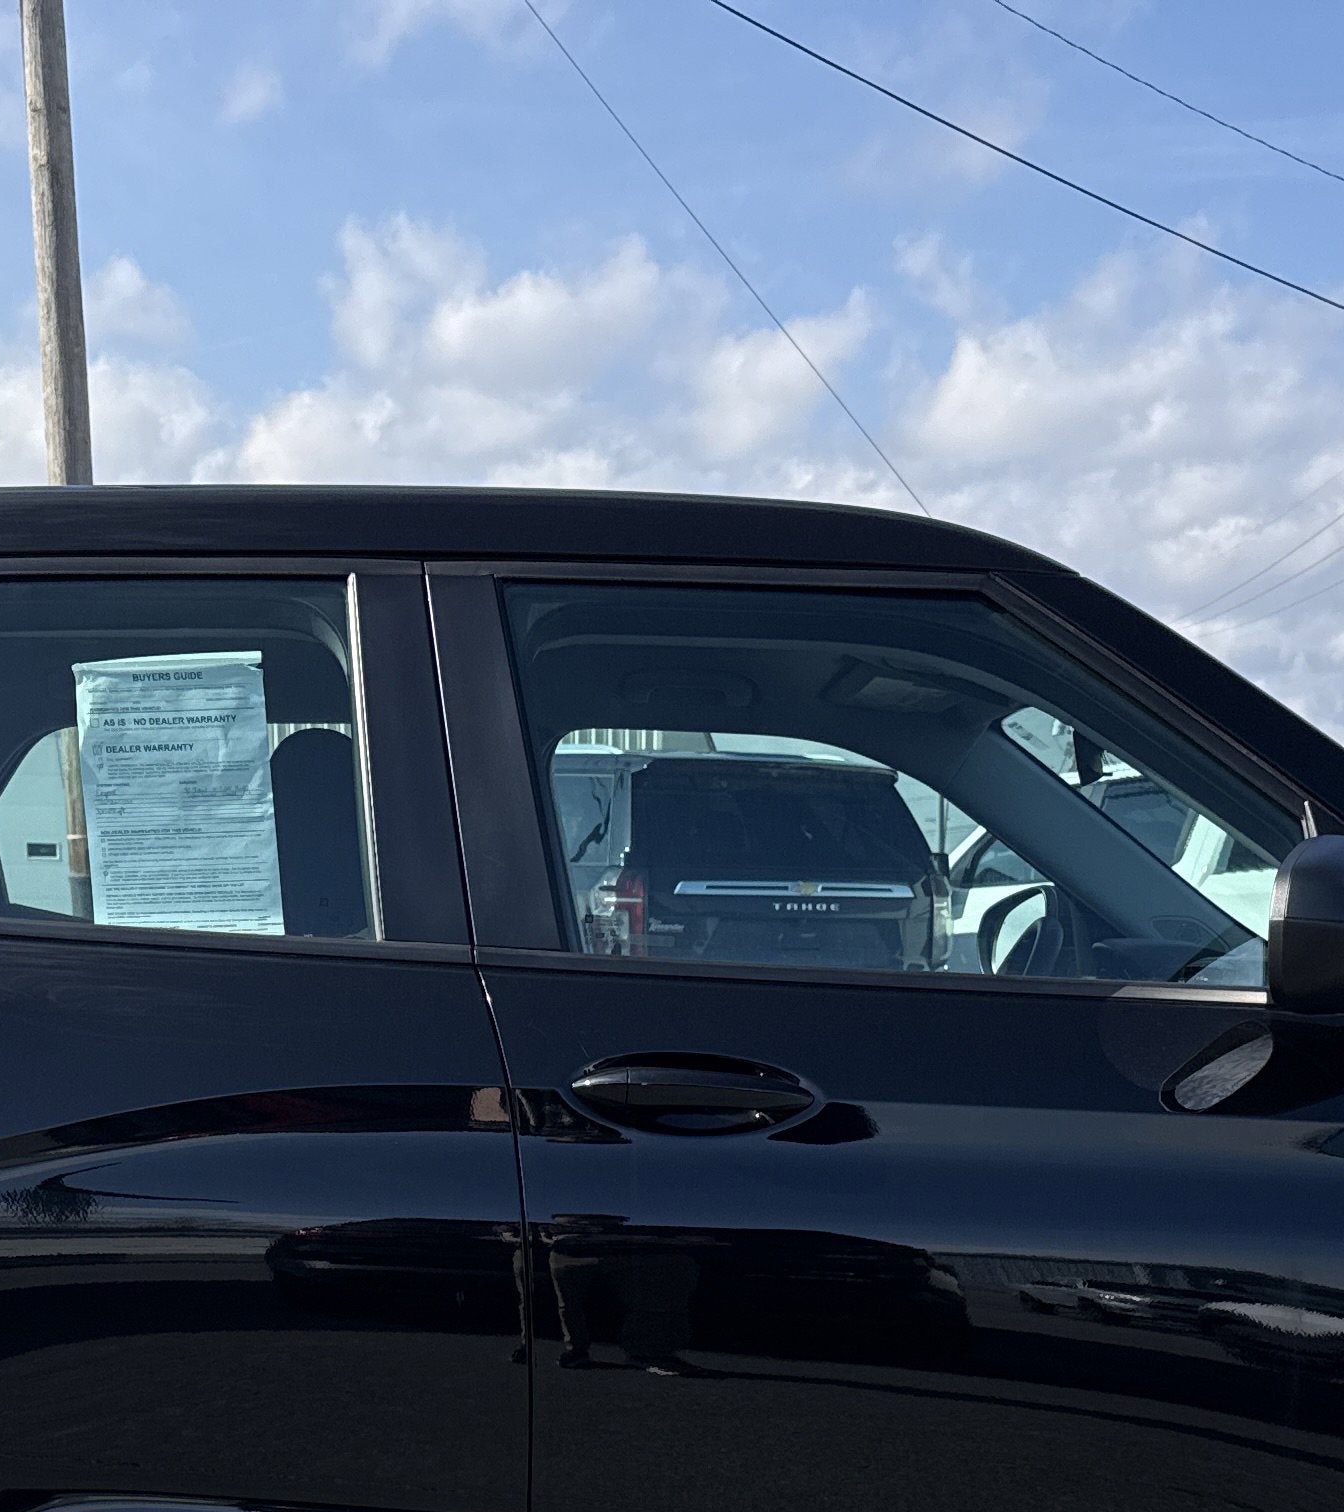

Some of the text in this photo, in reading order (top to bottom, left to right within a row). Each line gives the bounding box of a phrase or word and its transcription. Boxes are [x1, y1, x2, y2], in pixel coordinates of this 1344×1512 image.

[132, 671, 203, 682] BUYERS GUIDE
[103, 714, 236, 727] AS IS NO DEALER WARRANTY
[106, 743, 194, 754] DEALER WARRANTY
[772, 902, 840, 911] TAHOE
